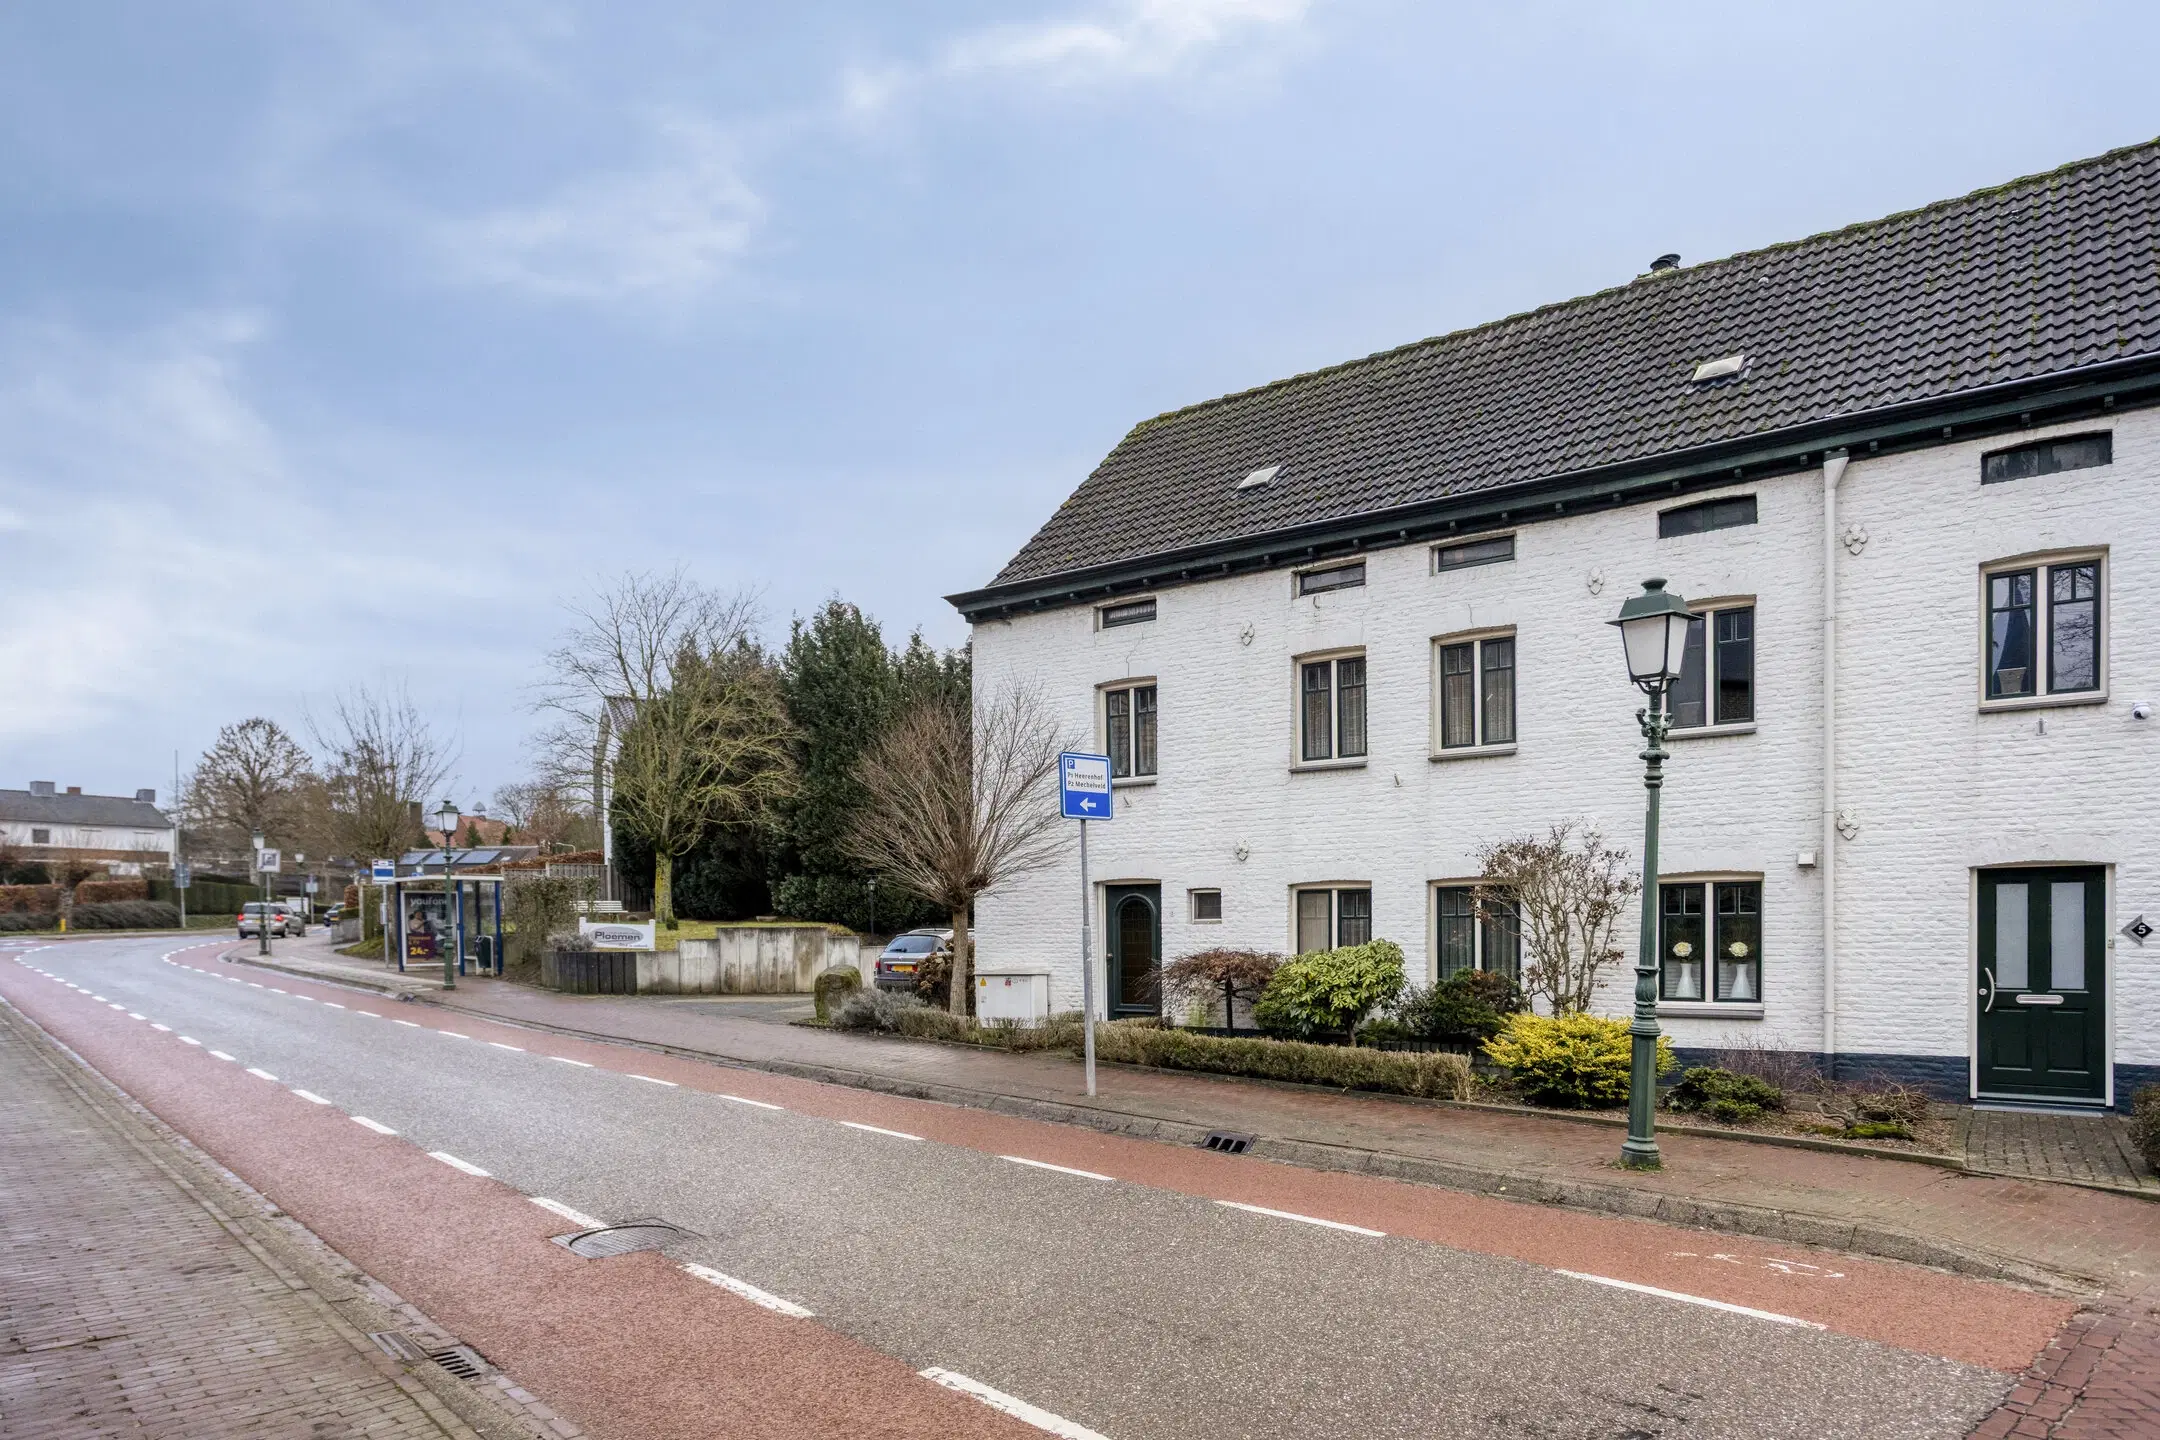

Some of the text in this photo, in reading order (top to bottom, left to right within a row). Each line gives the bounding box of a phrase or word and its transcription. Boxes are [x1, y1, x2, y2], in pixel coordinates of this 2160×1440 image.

[1074, 772, 1104, 781] Heerenhof
[1075, 781, 1106, 789] Mechelveld
[2138, 925, 2147, 935] 5
[594, 931, 641, 941] Ploemen
